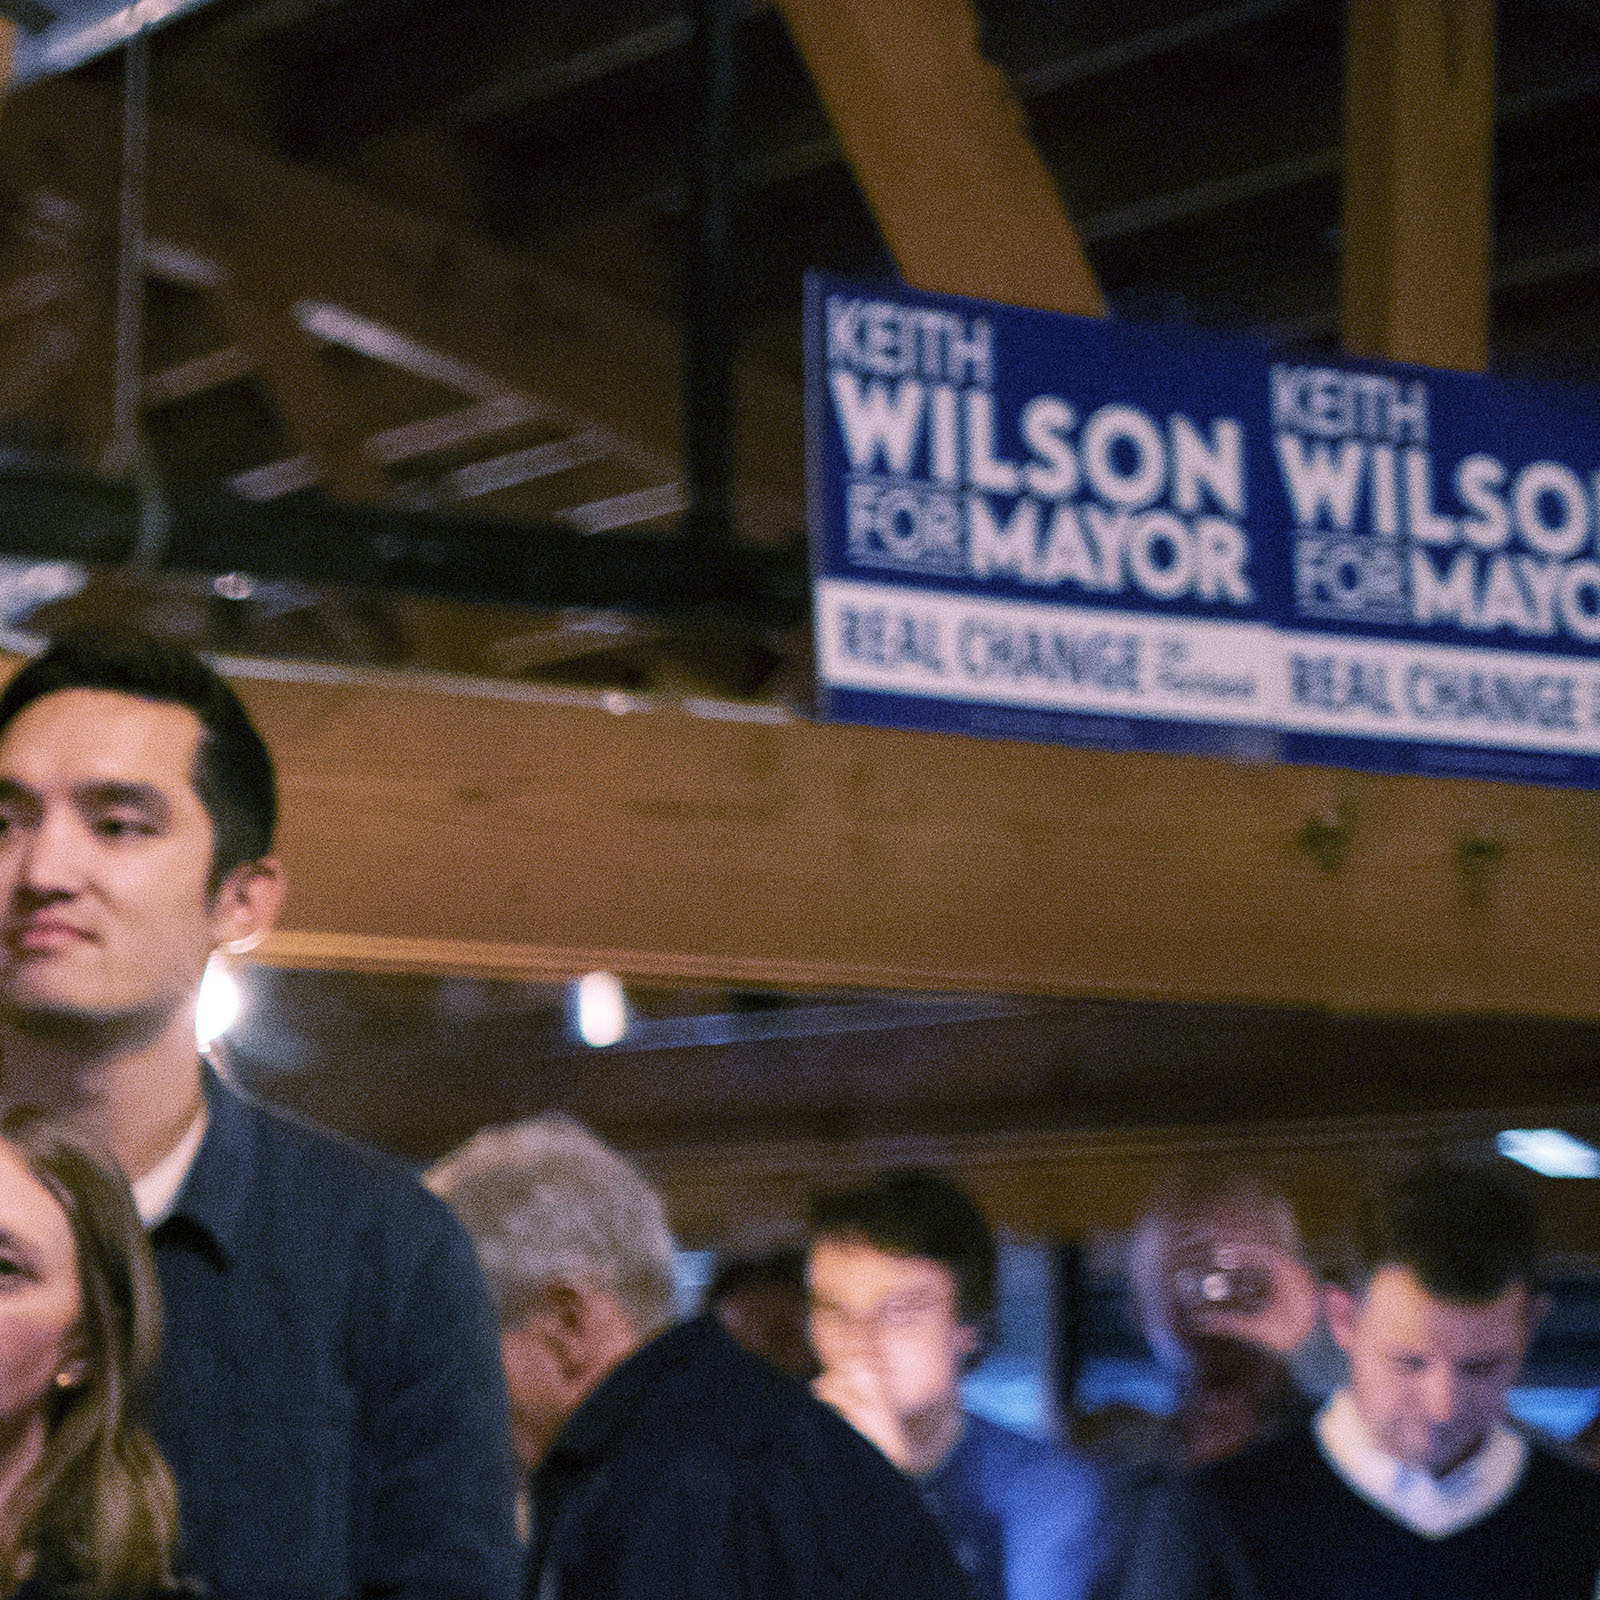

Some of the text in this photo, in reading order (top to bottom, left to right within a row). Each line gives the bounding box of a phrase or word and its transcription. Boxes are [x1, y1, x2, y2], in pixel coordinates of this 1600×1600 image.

[827, 296, 994, 384] KEITH
[832, 373, 1247, 516] WILSON
[1271, 364, 1431, 438] KEITH
[1275, 435, 1600, 557] WILSO
[847, 482, 1256, 605] FOR MAYOR
[1296, 536, 1408, 621] FOR
[838, 604, 944, 676] REAL
[958, 617, 1144, 697] CHANGE
[1290, 652, 1394, 717] REAL
[1406, 661, 1578, 732] CHANGE
